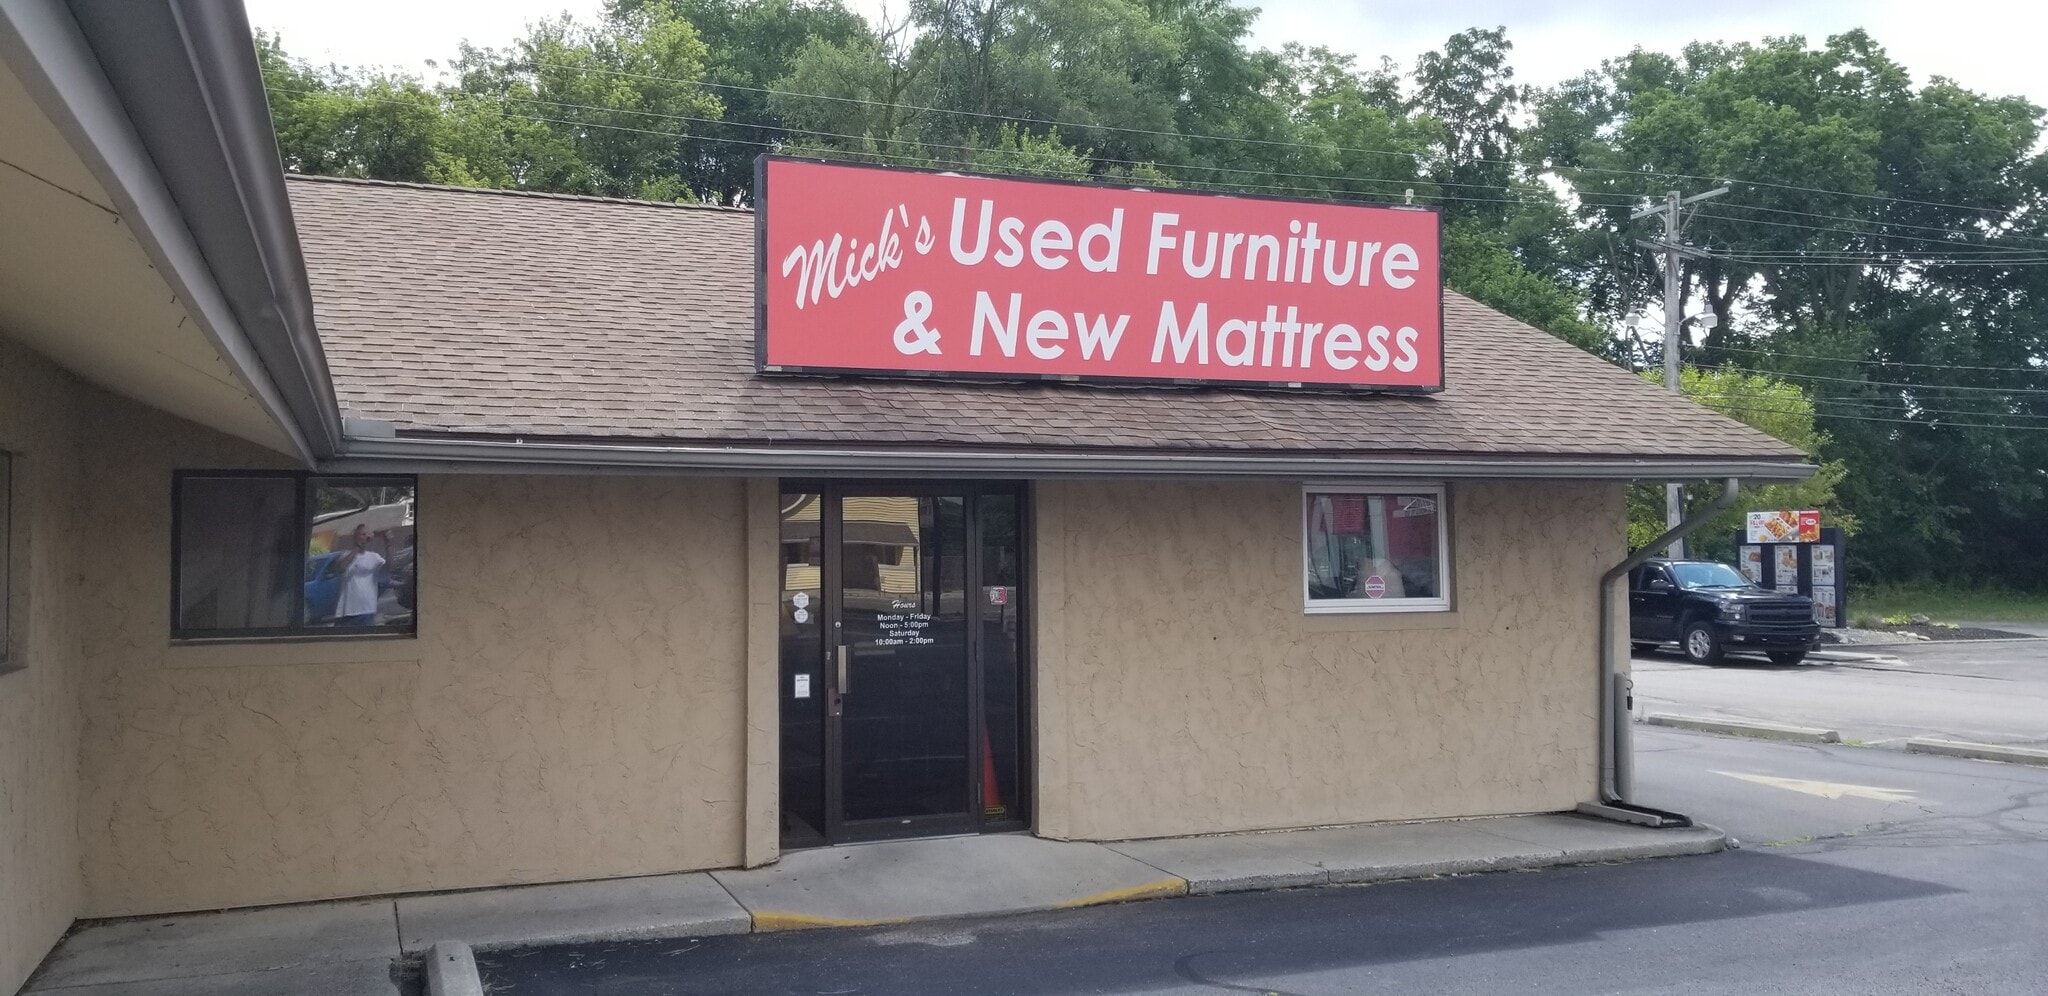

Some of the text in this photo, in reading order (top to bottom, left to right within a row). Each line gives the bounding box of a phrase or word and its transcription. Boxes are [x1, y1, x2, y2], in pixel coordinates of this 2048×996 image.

[782, 197, 1420, 310] Mick's Used Furniture
[892, 290, 1419, 373] & New Mattress
[892, 600, 915, 609] Hours
[910, 613, 931, 621] Friday
[904, 621, 928, 629] 5:00pm
[875, 638, 903, 646] 10:00am
[909, 637, 933, 645] 2:00pm
